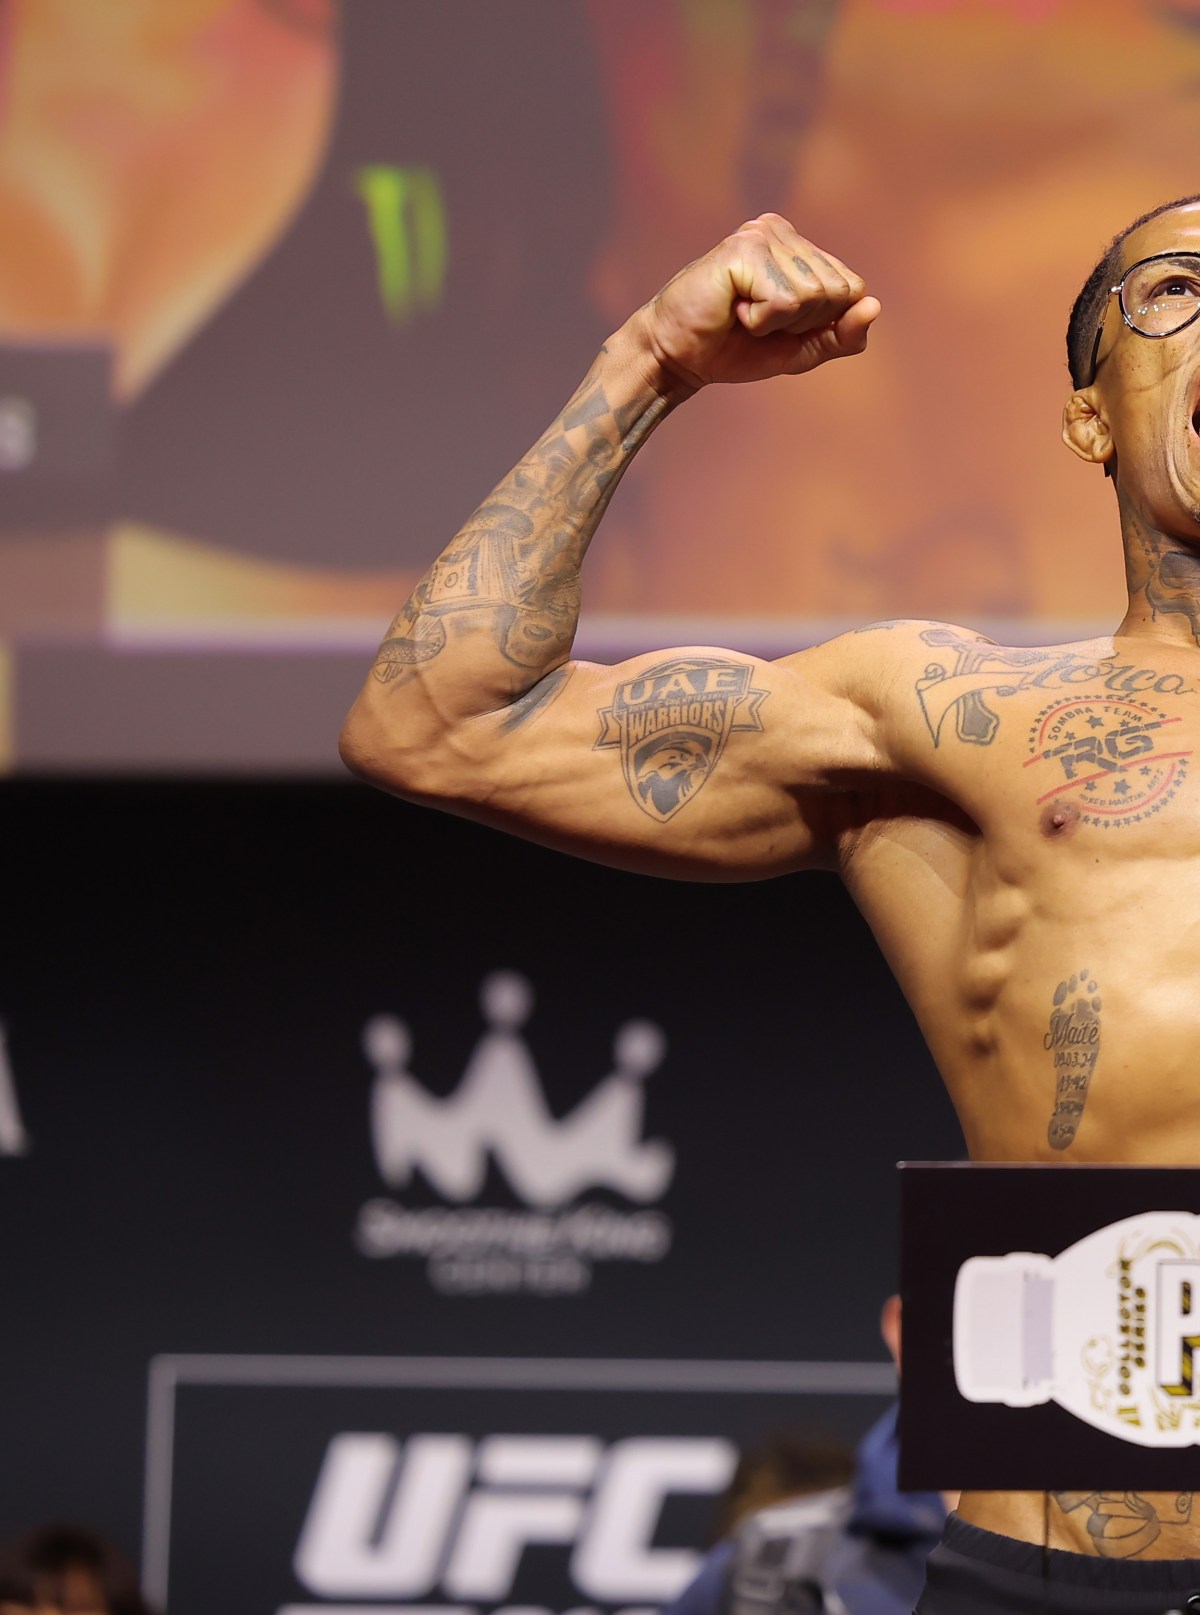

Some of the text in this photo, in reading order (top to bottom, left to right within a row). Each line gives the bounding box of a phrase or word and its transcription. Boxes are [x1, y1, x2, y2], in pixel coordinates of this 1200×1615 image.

[622, 668, 738, 705] UAE
[628, 700, 725, 741] WARRIORS
[1047, 705, 1143, 742] SOMBRA TEAM
[1043, 1012, 1100, 1051] Maitê
[1119, 1259, 1131, 1396] COLLECTOR
[293, 1433, 737, 1600] UFC
